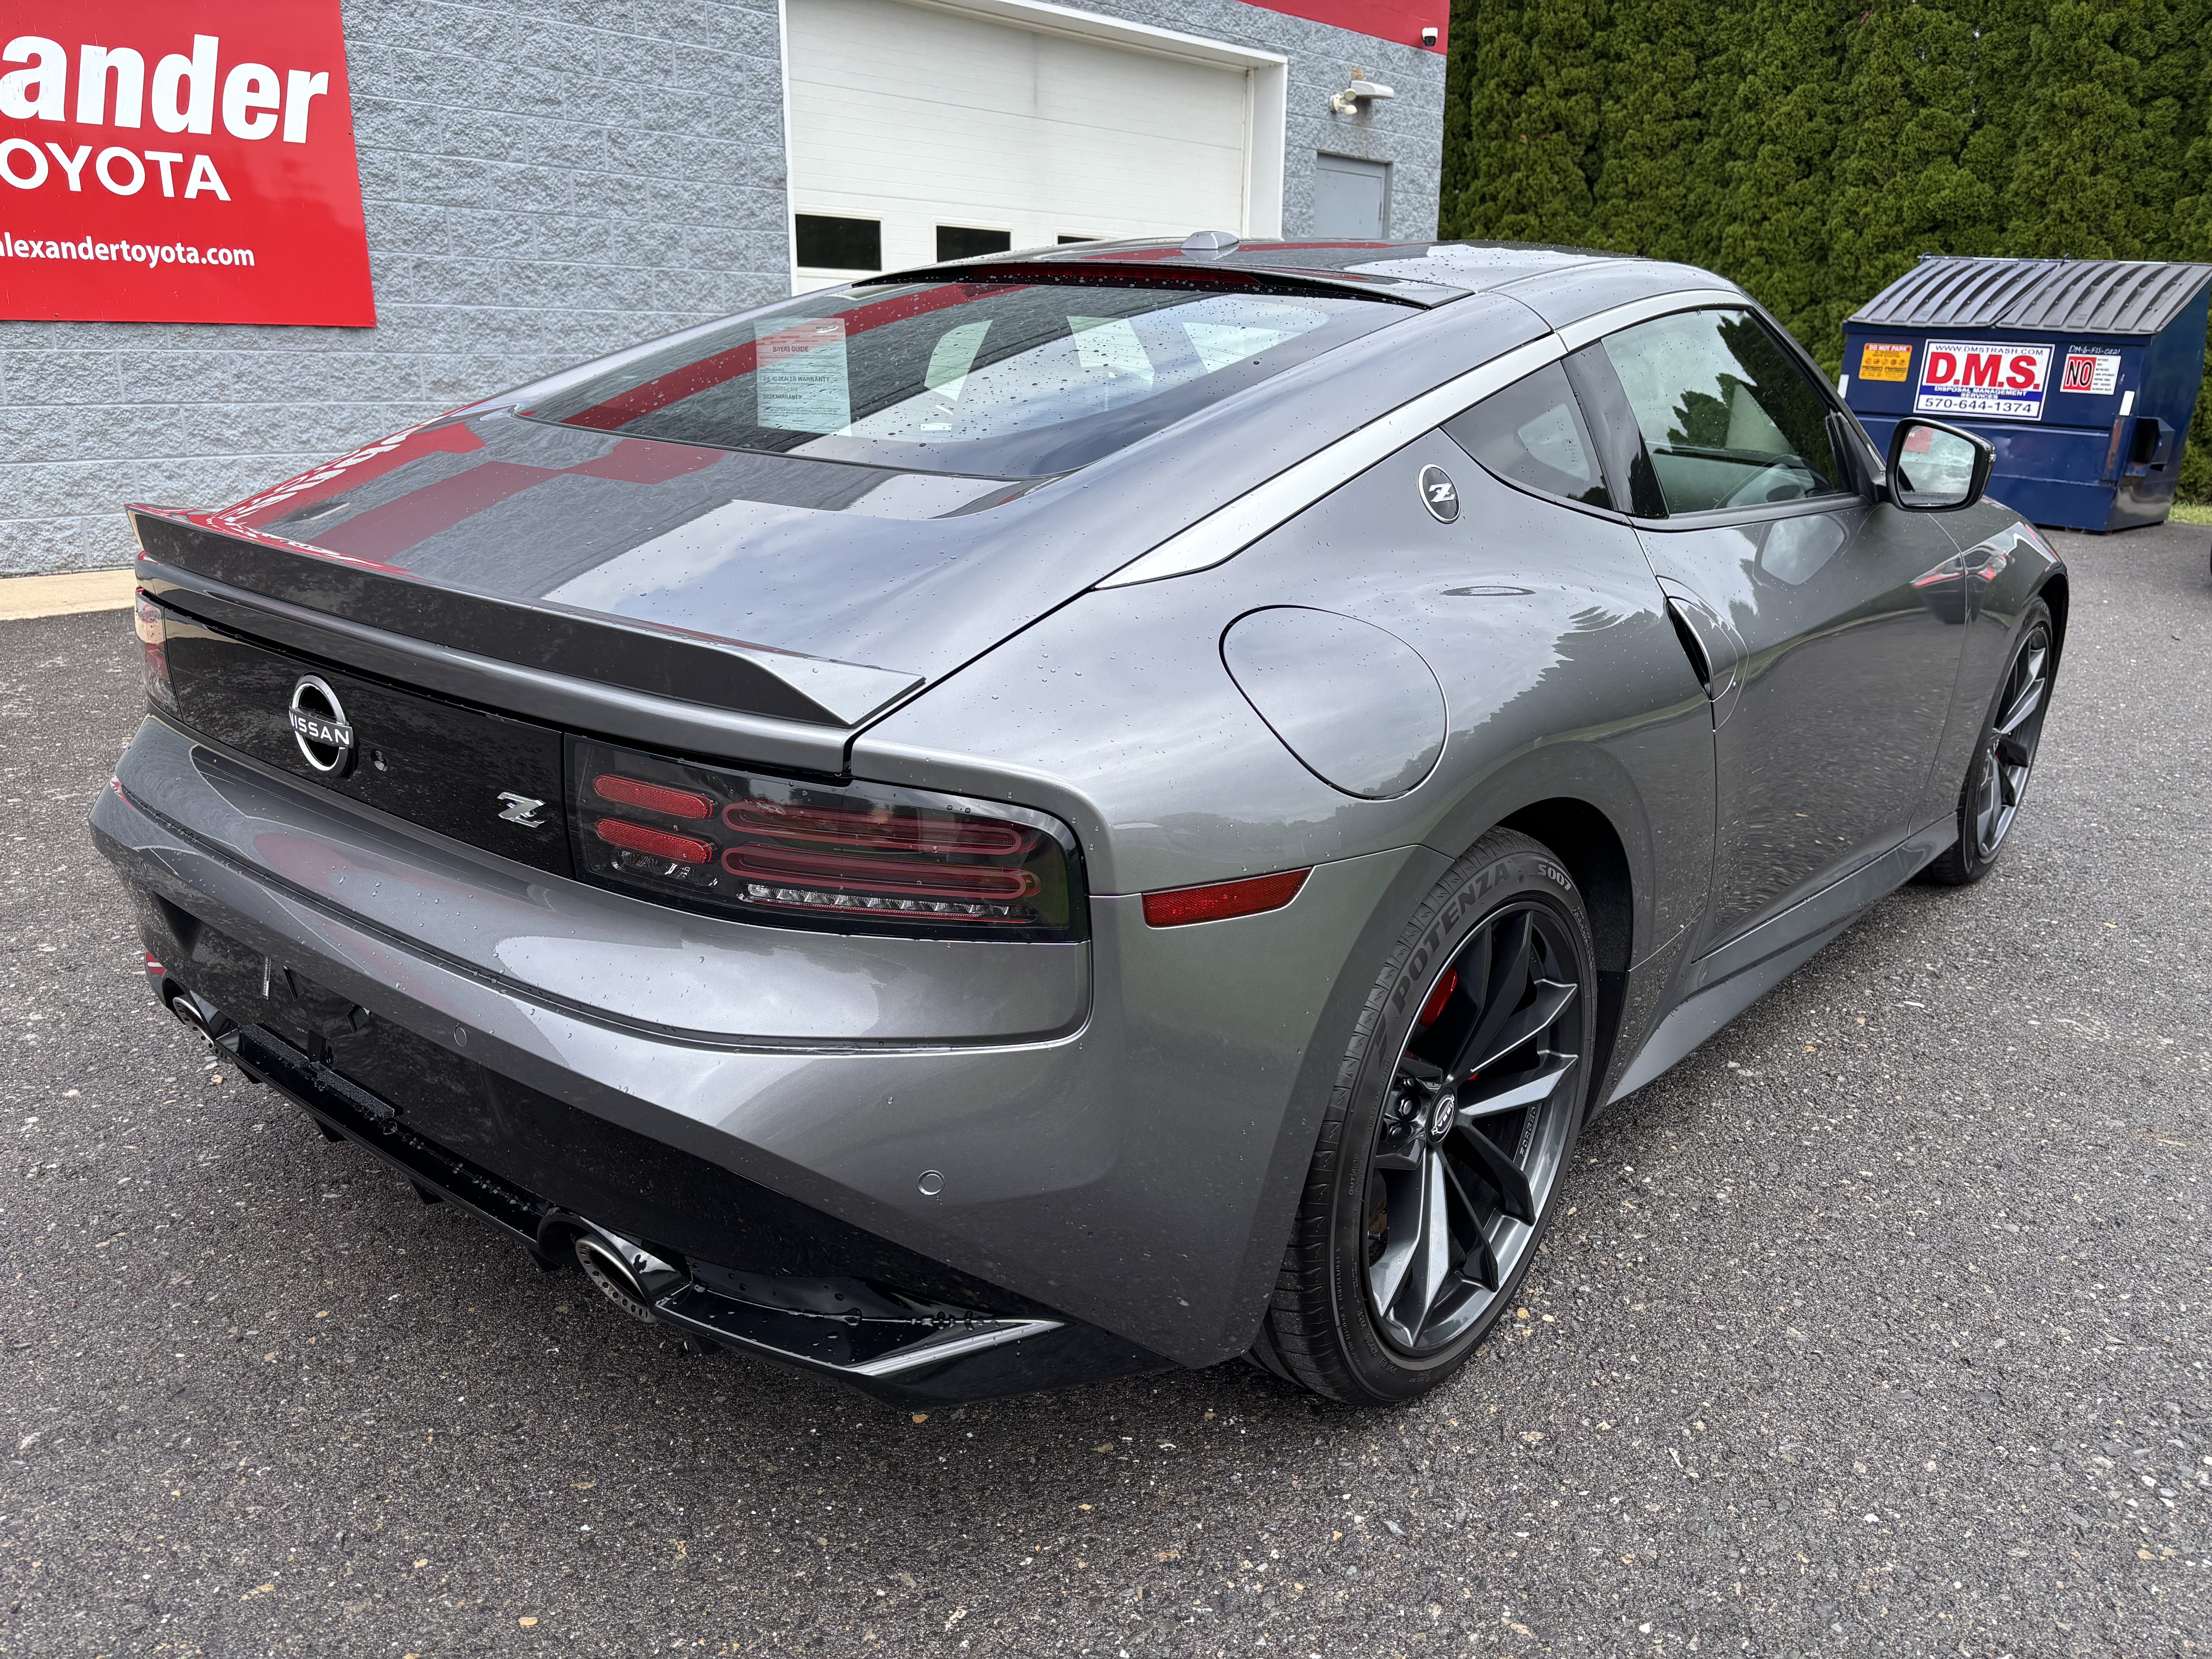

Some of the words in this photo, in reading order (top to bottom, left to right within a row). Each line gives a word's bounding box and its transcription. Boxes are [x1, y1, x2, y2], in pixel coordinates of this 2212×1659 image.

[0, 34, 329, 143] ander
[0, 138, 231, 201] OYOTA
[0, 232, 255, 269] lexandertoyota.com
[1936, 345, 2043, 356] WWW.DMSTRASH.COM
[1926, 352, 2040, 390] D.M.S.
[2065, 359, 2094, 388] NO
[1925, 398, 2032, 413] 570-644-1374
[1973, 388, 2027, 396] MANAGEMENT
[1429, 483, 1455, 503] Z
[289, 710, 350, 745] NISSAN
[497, 792, 548, 828] Z
[1391, 862, 1511, 1015] POTENZA
[1519, 1107, 1537, 1158] FORGED
